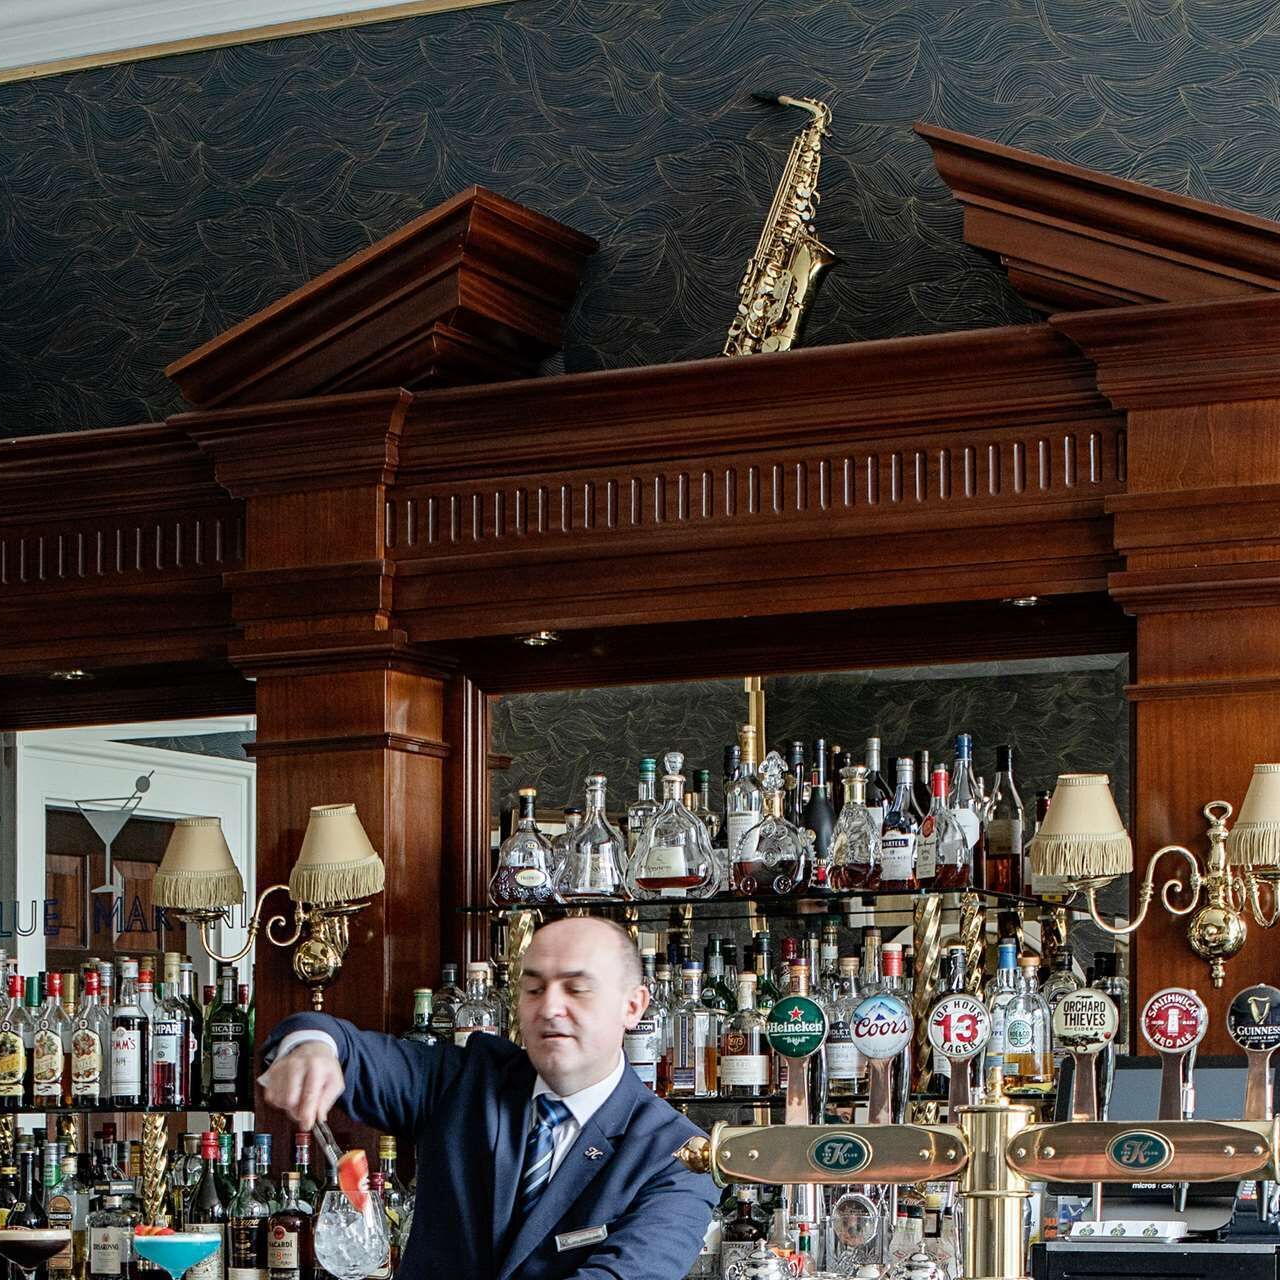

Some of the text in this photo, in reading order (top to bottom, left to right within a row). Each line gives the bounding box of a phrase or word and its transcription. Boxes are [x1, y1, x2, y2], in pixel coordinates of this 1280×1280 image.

[94, 890, 248, 935] MARNI
[933, 1000, 983, 1027] HOP HOUSE
[1063, 1001, 1106, 1013] ORCHARD
[770, 1021, 823, 1034] Heineken
[854, 1017, 908, 1039] Coors
[936, 1014, 979, 1043] 13
[1063, 1013, 1106, 1026] THIEVES
[941, 1041, 977, 1054] LAGER
[1152, 1032, 1194, 1047] RED ALE
[823, 1142, 853, 1166] K
[1121, 1140, 1154, 1164] K
